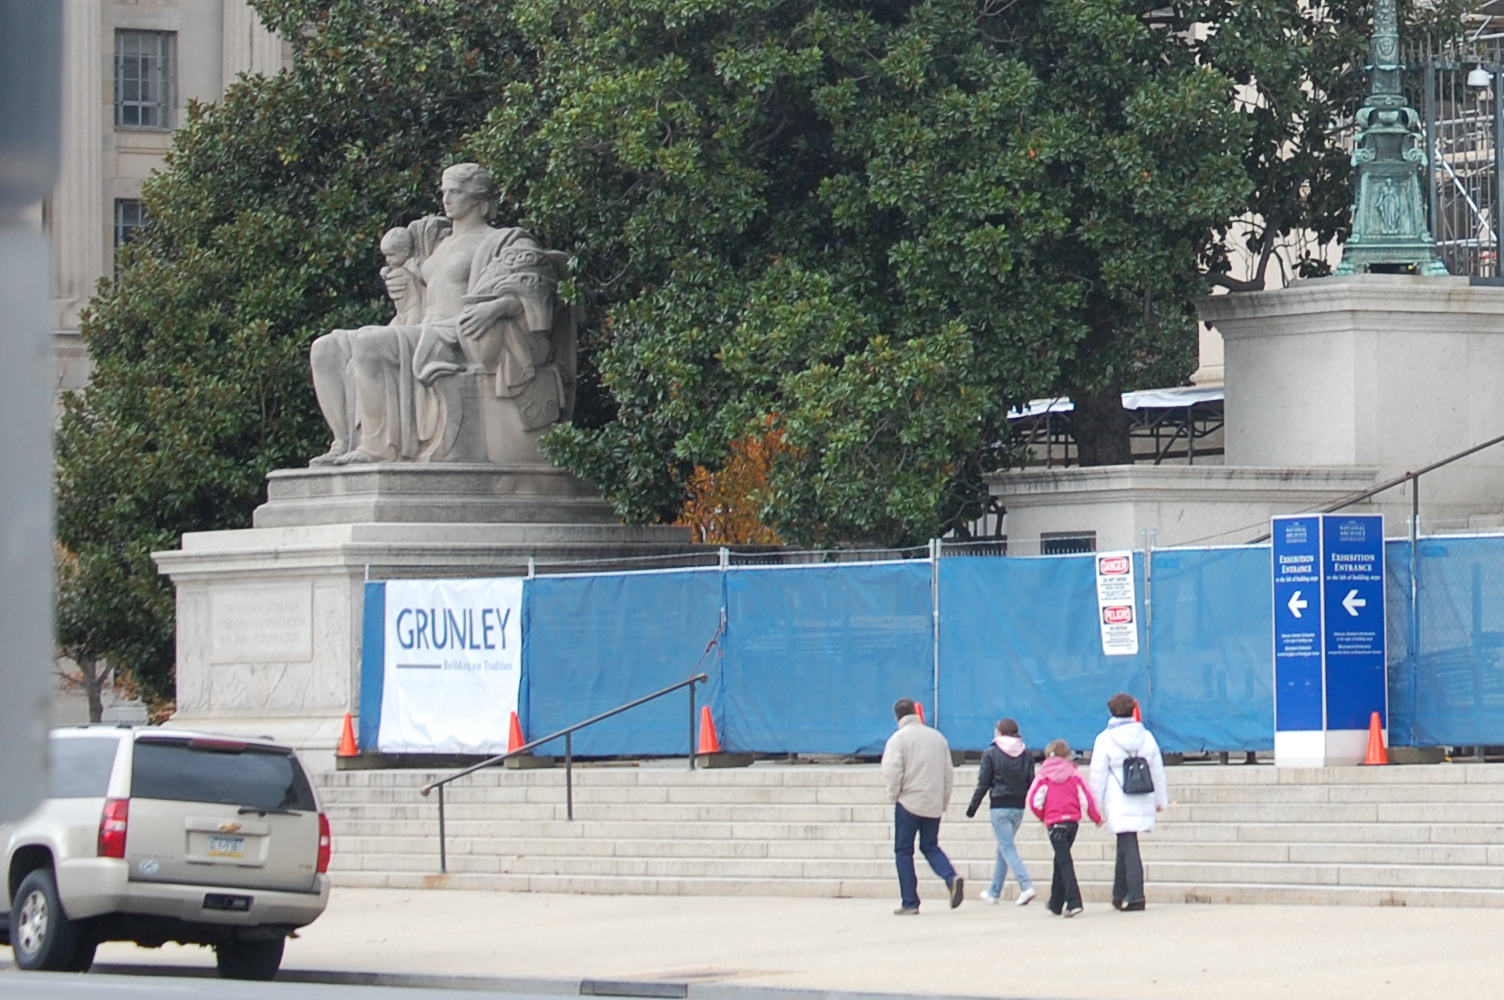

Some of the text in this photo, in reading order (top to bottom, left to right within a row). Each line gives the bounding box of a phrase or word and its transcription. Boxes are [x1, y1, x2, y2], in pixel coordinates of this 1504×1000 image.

[1279, 555, 1314, 564] EXHIBITION
[1331, 552, 1375, 562] EXHIBITION
[1282, 564, 1312, 574] ENTRANCE
[1334, 562, 1372, 571] ENTRANCE
[397, 608, 511, 649] GRUNLEY
